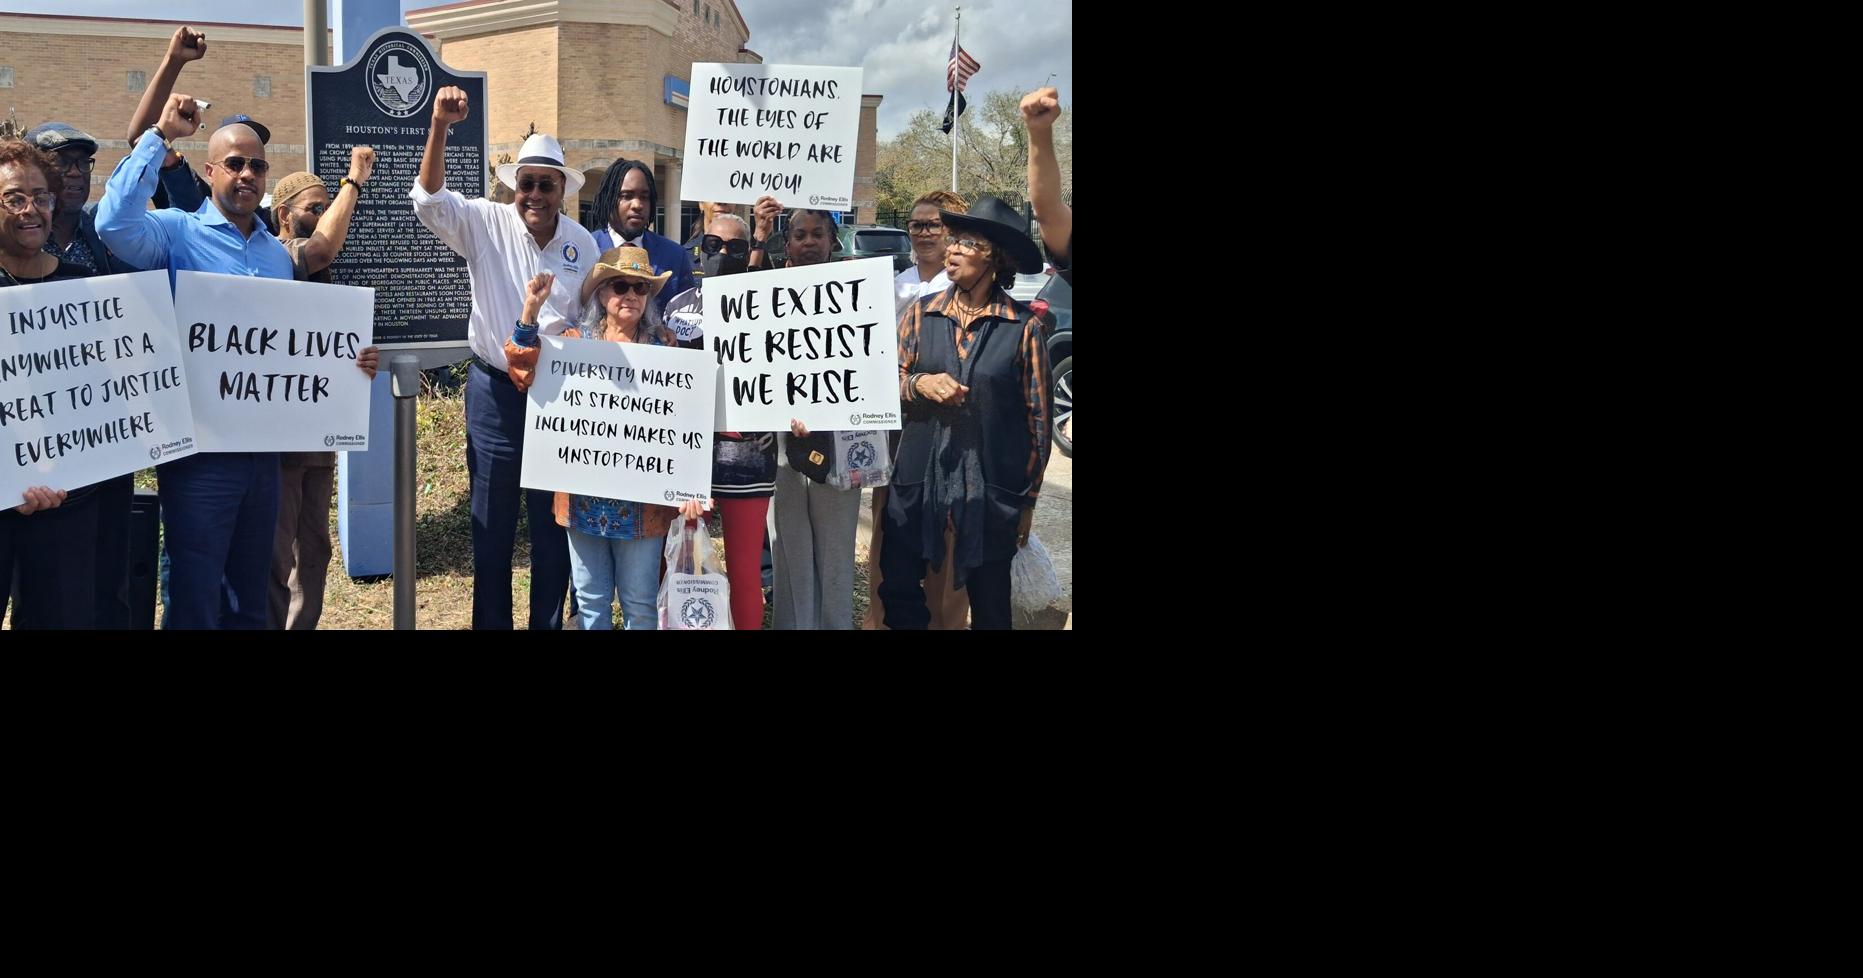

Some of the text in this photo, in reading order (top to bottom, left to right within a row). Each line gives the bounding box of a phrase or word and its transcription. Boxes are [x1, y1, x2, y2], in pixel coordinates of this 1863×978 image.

[384, 75, 413, 85] TEXAS
[345, 125, 398, 134] HOUSTON'S
[401, 127, 426, 136] FIRST
[717, 107, 829, 130] THE EYES OF
[697, 138, 843, 164] THE WORLD ARE
[729, 170, 802, 195] ON YOU!
[8, 297, 124, 335] INJUSTICE
[720, 277, 872, 323] WE EXIST.
[188, 322, 360, 360] BLACK LIVES
[713, 322, 885, 365] WE RESIST.
[0, 332, 155, 383] NYWHERE IS A
[219, 370, 329, 403] MATTER
[550, 359, 693, 390] DIVERSITY MAKES
[733, 368, 865, 406] WE RISE.
[0, 366, 181, 427] REAT TO JUSTICE
[563, 389, 677, 417] US STRONGER.
[14, 412, 154, 467] EVERYWHERE
[535, 415, 703, 450] INCLUSION MAKES US
[558, 445, 675, 475] UNSTOPPABLE
[676, 490, 695, 499] Rodney
[676, 586, 719, 595] Rodney Ellis
